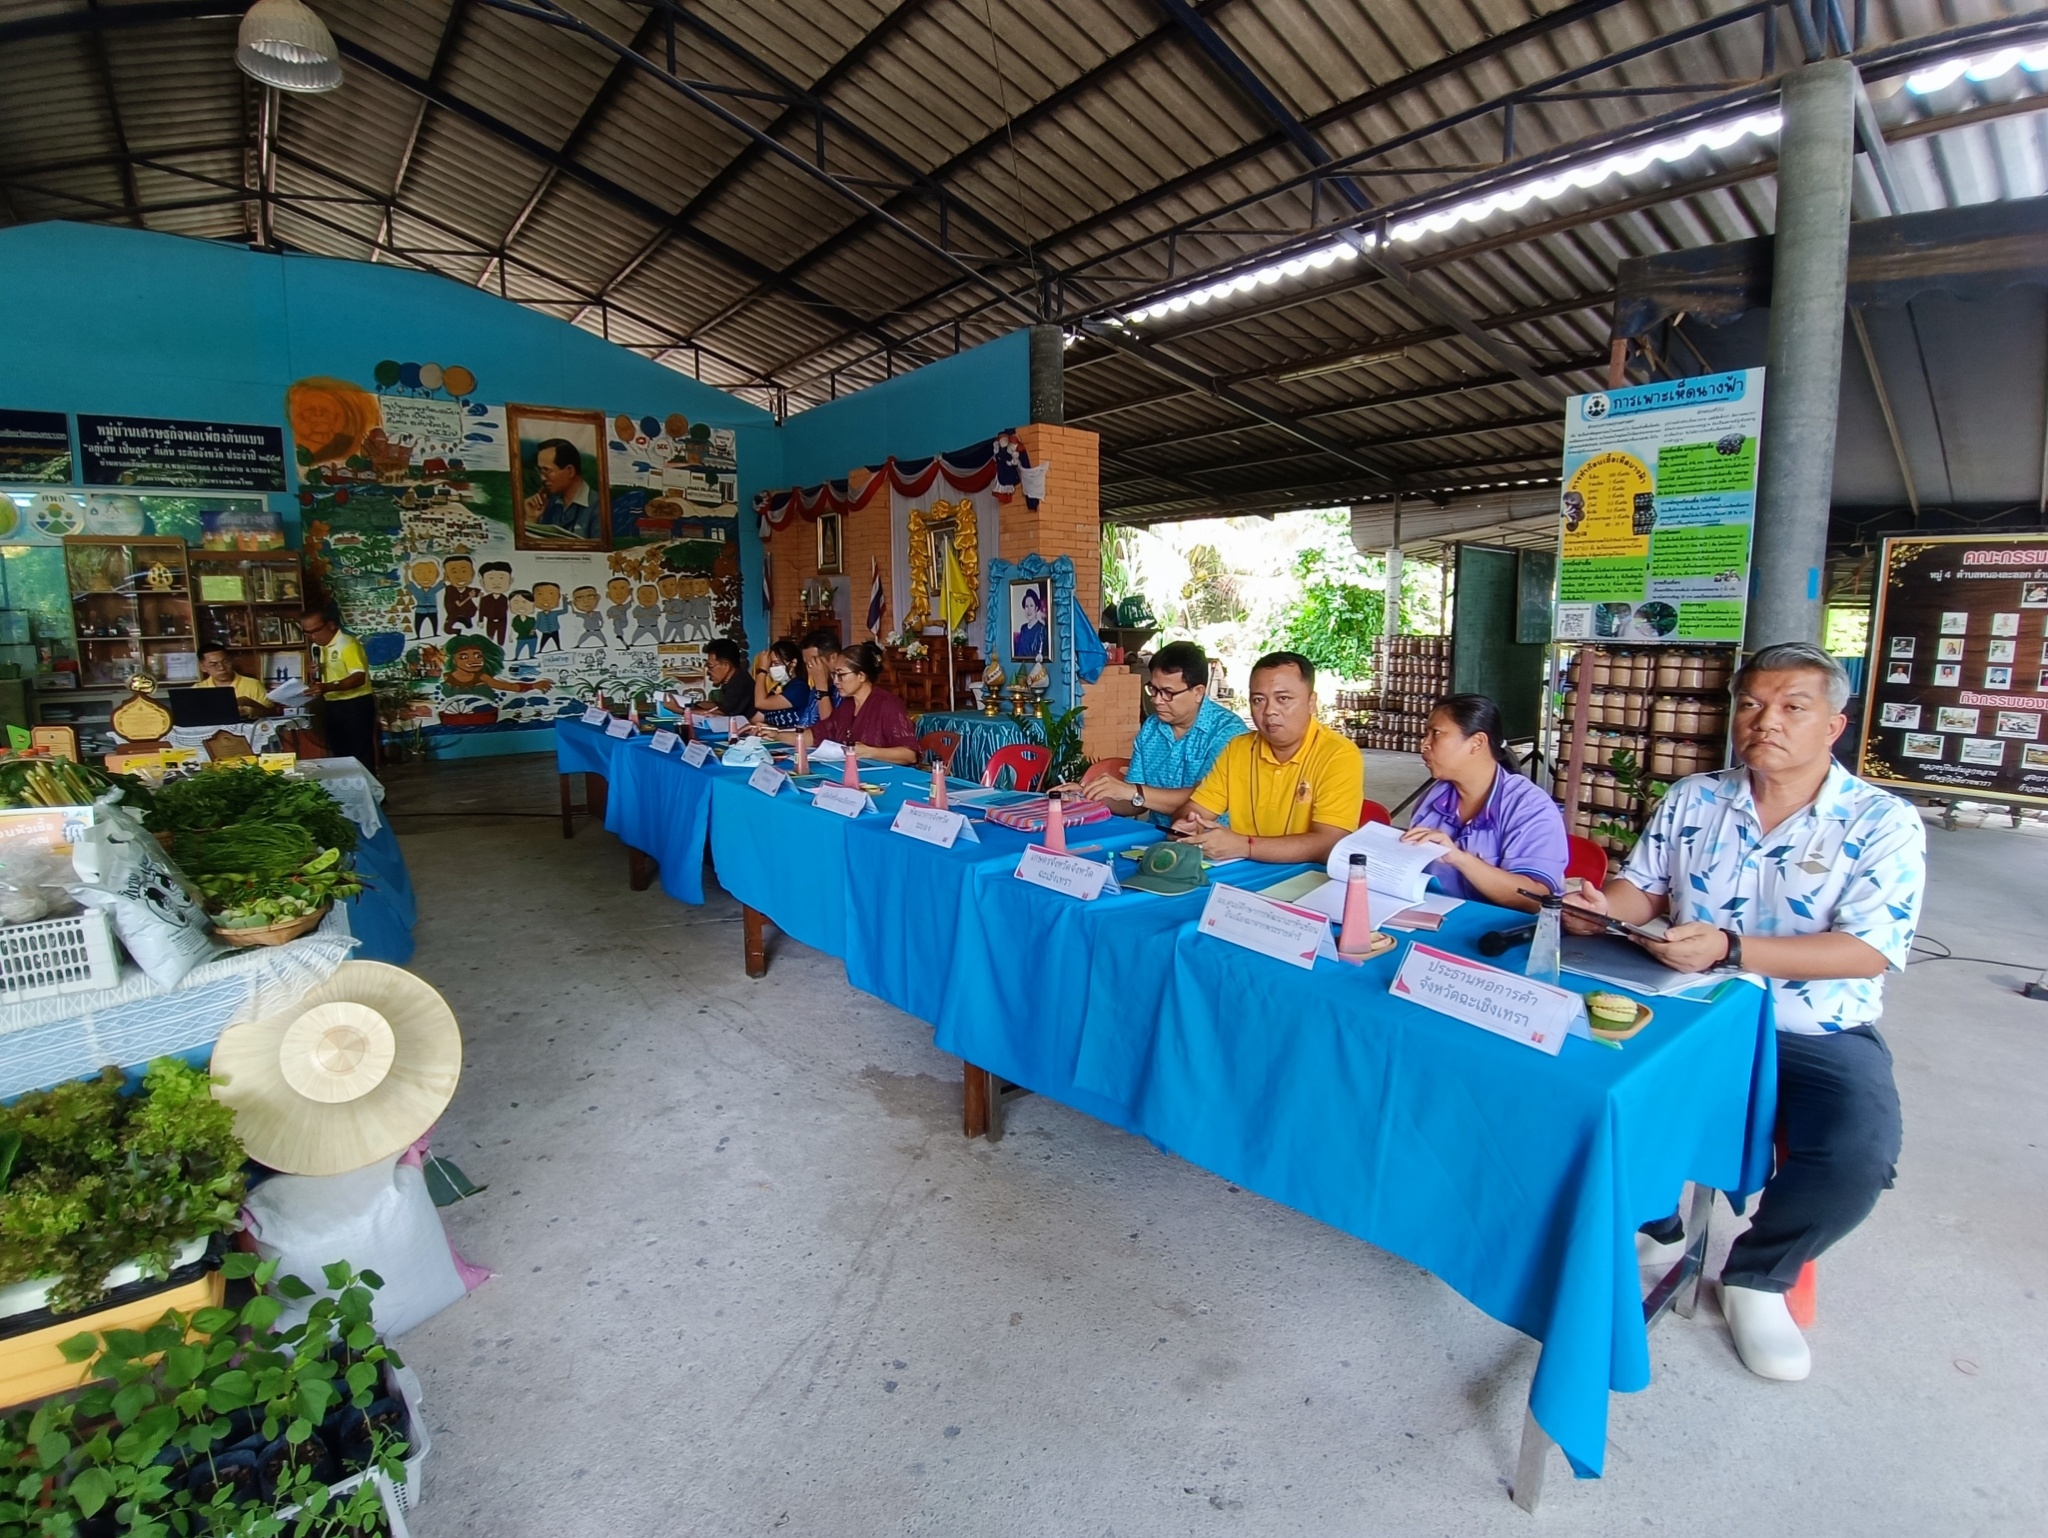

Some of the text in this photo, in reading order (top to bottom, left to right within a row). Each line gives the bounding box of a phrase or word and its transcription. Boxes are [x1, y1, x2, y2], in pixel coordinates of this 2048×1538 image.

[1612, 376, 1744, 411] การเพาะเห็ดนางฟ้า
[97, 421, 265, 446] หมู่บ้านเศรษฐกิจพอเพียงต้นแบบ
[177, 447, 224, 459] ระดับจังหวัด
[226, 449, 257, 461] ประจำปี
[1963, 549, 2048, 565] คณะกรรม
[1929, 569, 1943, 582] หมู่
[1944, 571, 1952, 579] 4
[1038, 869, 1072, 887] ฉะเชิงเทรา
[1224, 909, 1302, 941] อันเนื่องมาจากพระราชดำริ
[1428, 960, 1539, 1007] ประธานหอการค้า
[1419, 977, 1530, 1028] จังหวัดฉะเชิงเทรา
